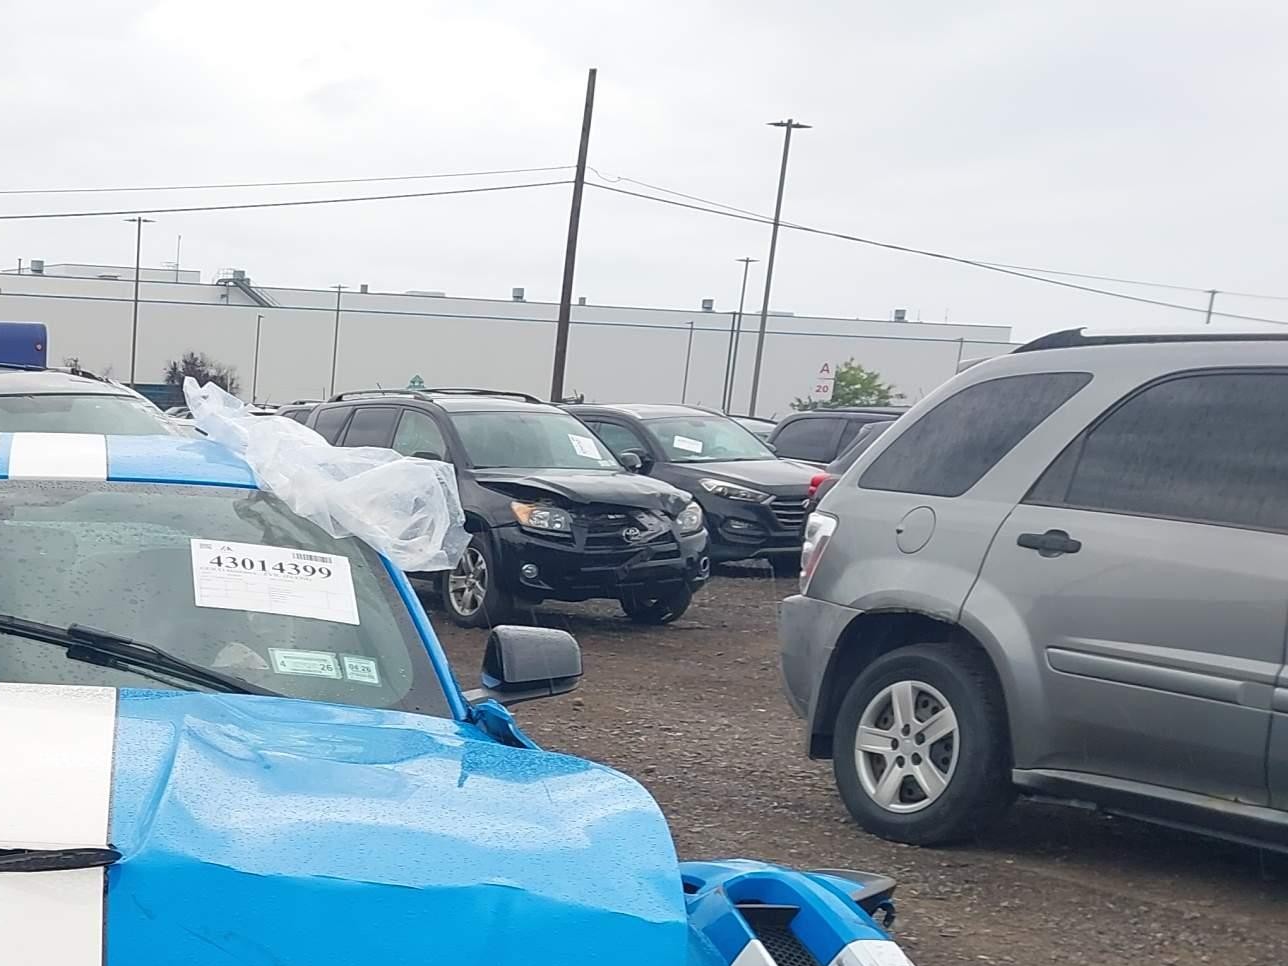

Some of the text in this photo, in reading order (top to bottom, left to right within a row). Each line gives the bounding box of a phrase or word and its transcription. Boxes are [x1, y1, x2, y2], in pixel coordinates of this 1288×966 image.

[819, 362, 831, 374] A
[815, 384, 830, 393] 20
[209, 555, 332, 579] 43014399
[319, 663, 334, 672] 26
